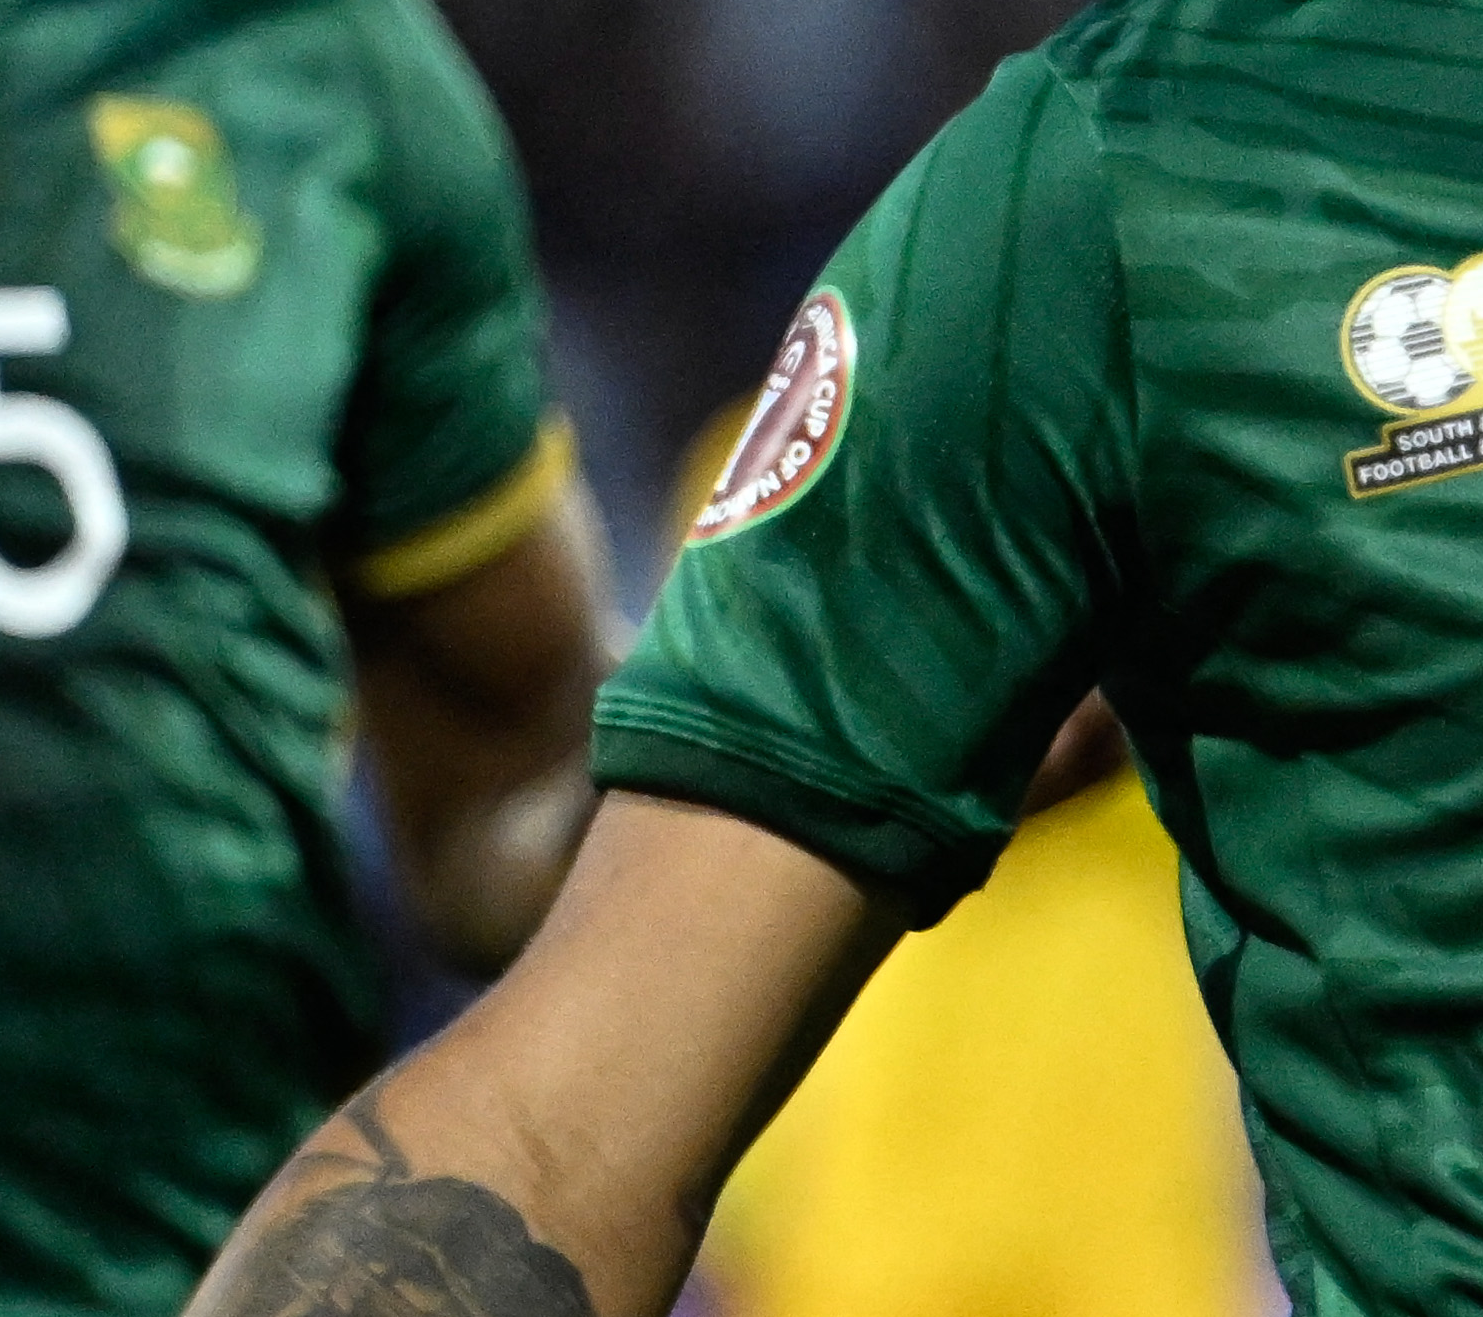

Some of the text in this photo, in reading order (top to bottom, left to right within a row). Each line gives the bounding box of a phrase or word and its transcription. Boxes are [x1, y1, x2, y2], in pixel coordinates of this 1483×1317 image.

[805, 379, 837, 439] CUP
[1395, 419, 1474, 453] SOUTH
[779, 439, 812, 482] OF
[1357, 443, 1474, 485] FOOTBALL
